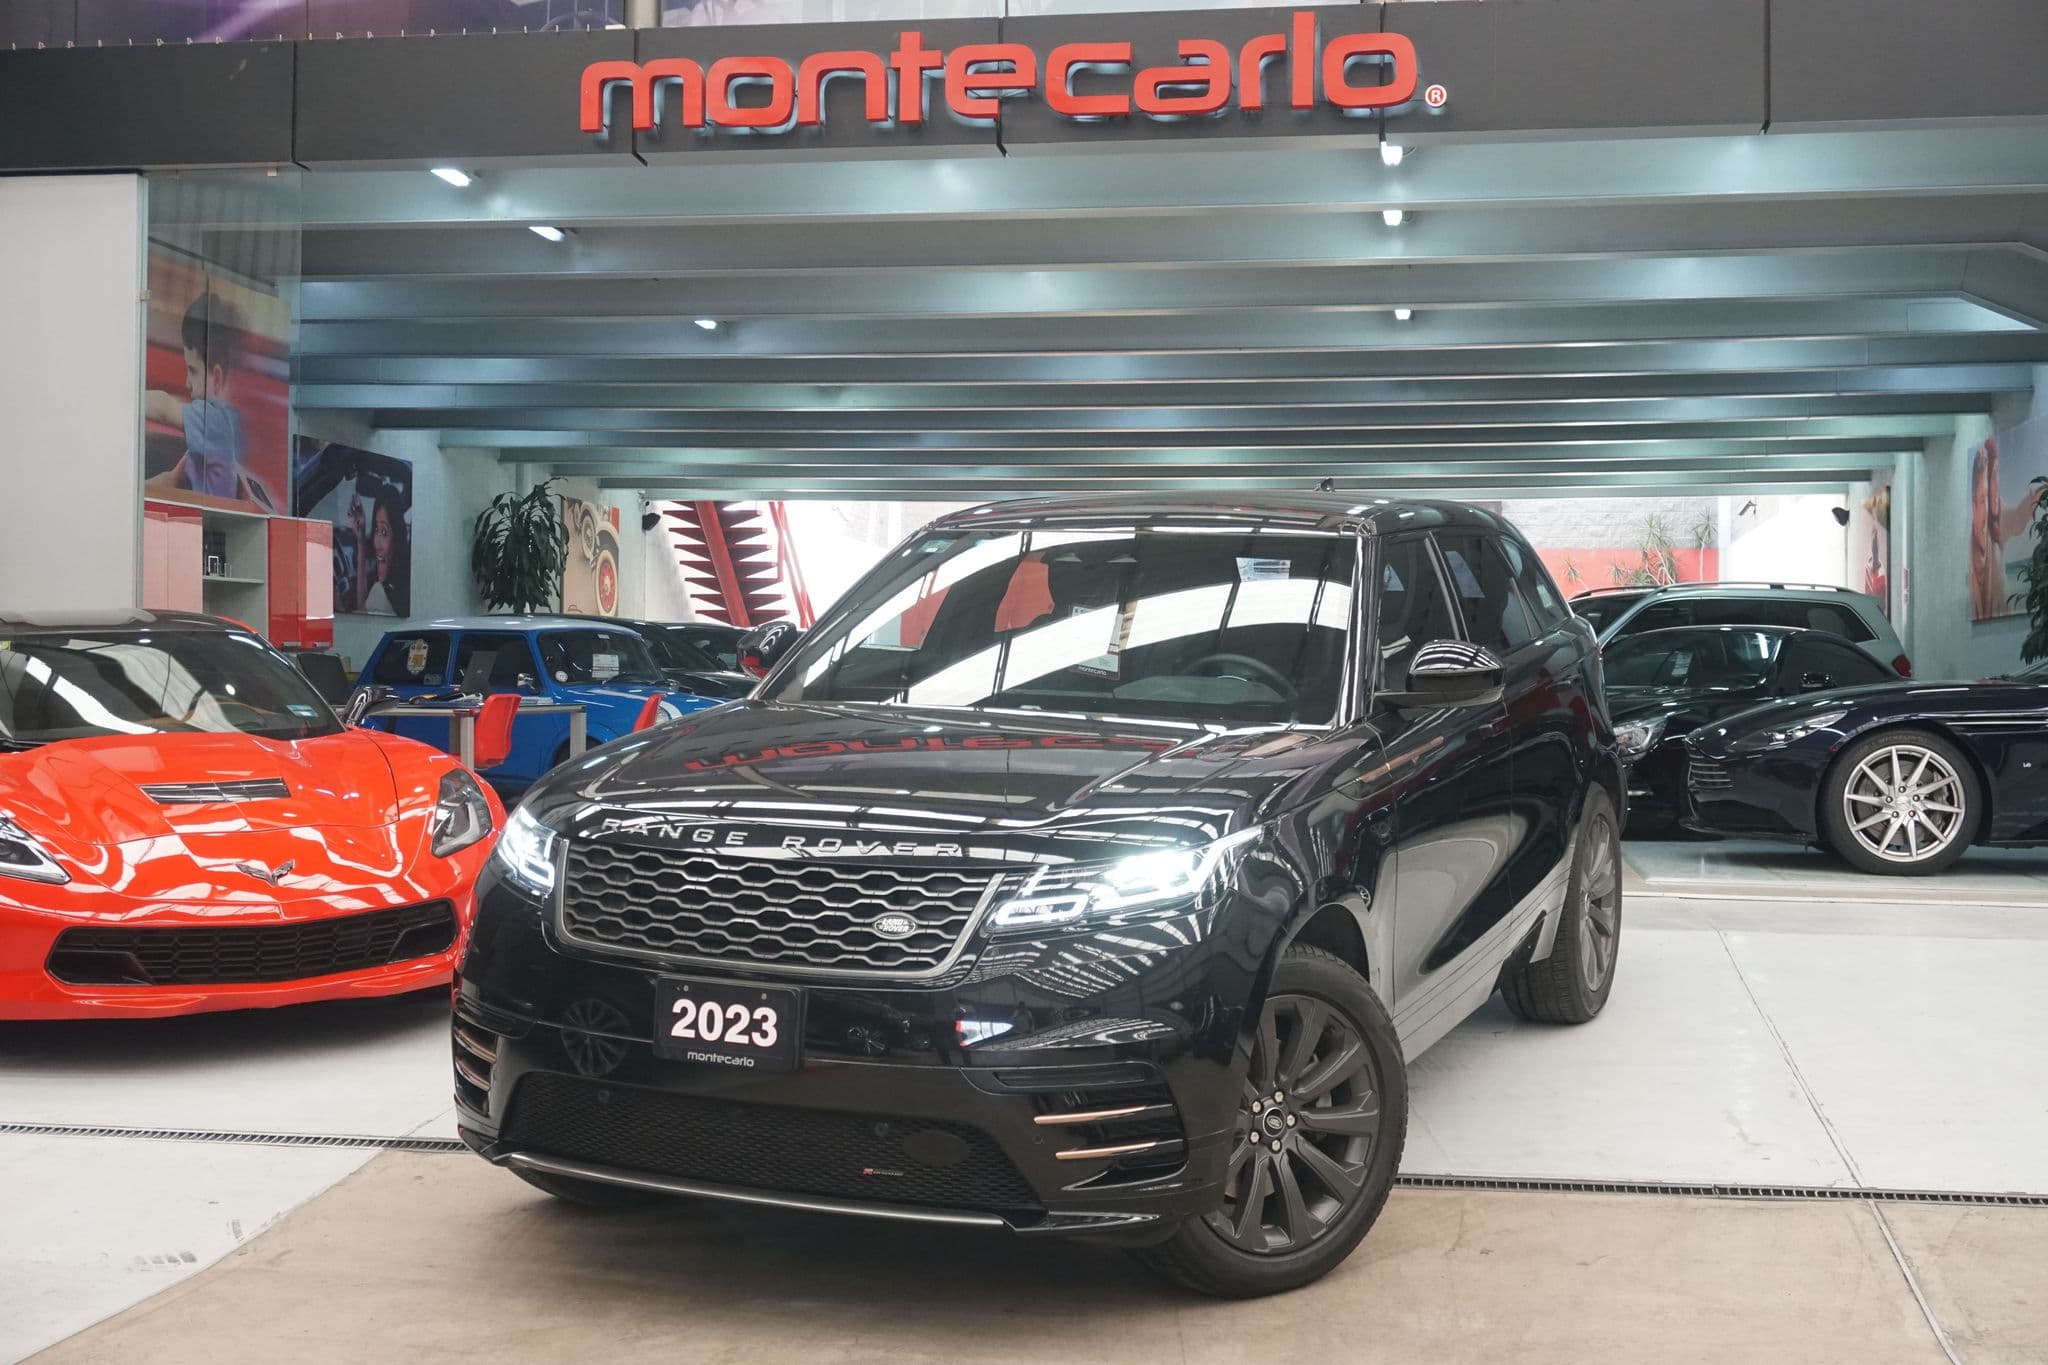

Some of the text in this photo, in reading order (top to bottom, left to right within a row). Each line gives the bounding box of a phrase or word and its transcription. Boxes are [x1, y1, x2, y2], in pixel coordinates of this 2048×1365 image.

[580, 11, 1418, 133] montecarlo
[601, 817, 964, 858] RANGE ROVER
[670, 998, 778, 1047] 2023
[687, 1051, 754, 1067] montecarlo
